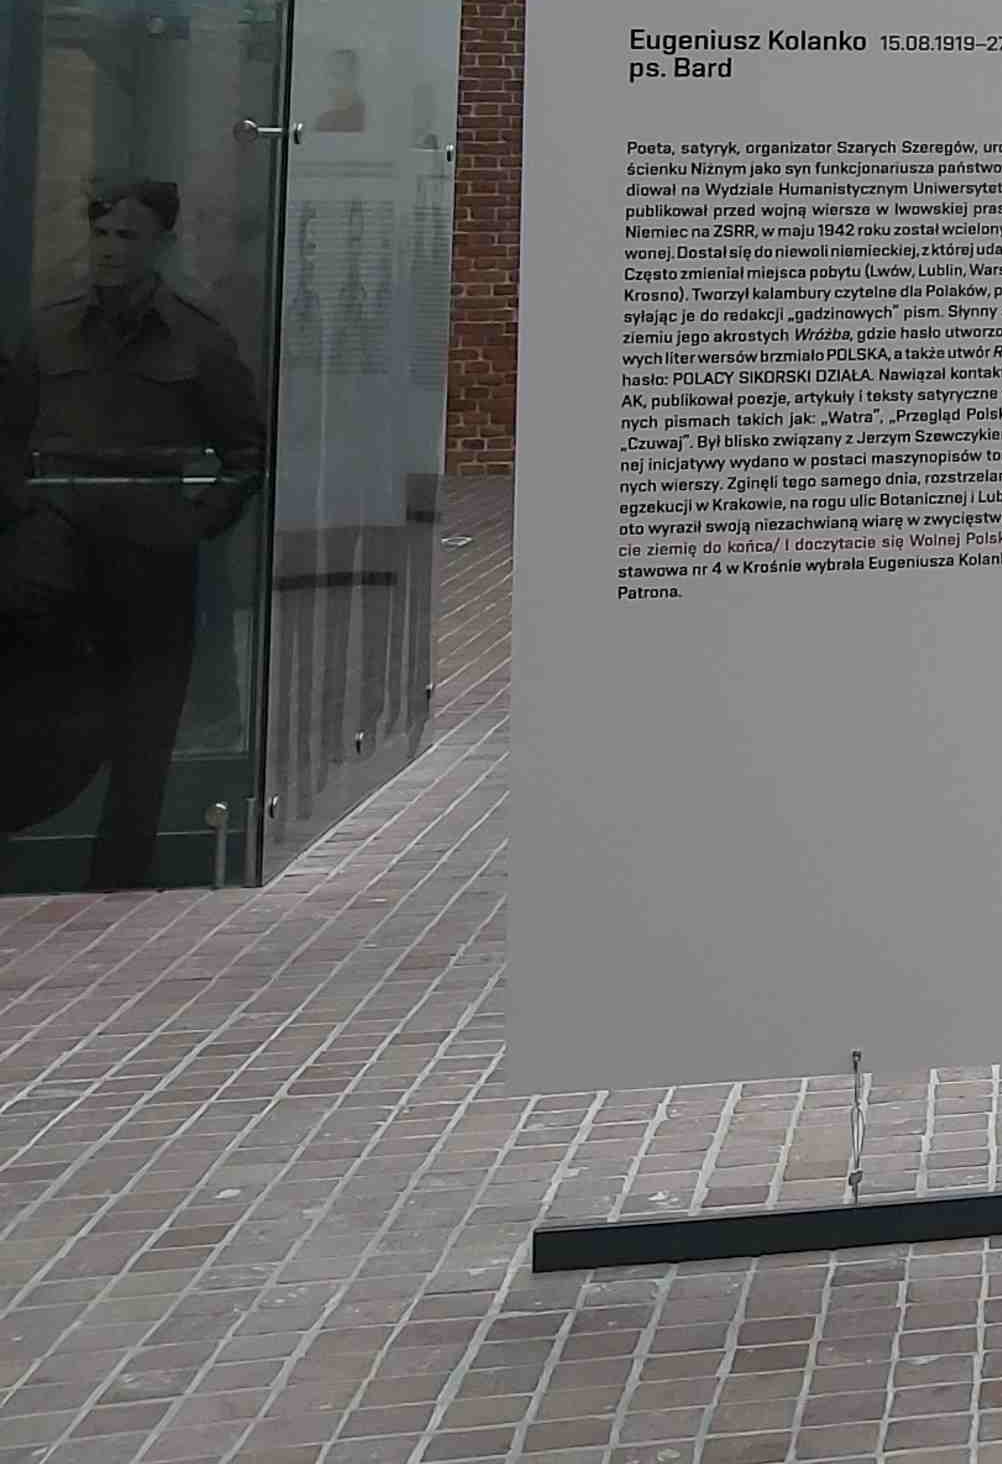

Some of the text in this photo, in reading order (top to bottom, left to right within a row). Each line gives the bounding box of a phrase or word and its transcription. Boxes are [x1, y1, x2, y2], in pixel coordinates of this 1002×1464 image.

[630, 29, 761, 55] Eugeniusz
[768, 30, 867, 50] Kolanko
[630, 57, 732, 83] ps. Bard
[627, 141, 675, 156] Poeta,
[680, 141, 740, 158] satyryk,
[745, 140, 832, 157] organizator
[836, 140, 896, 157] Szarych
[901, 140, 978, 156] Szeregów,
[626, 161, 687, 176] ścienku
[690, 161, 746, 178] Niżnym
[748, 160, 781, 178] jako
[784, 164, 811, 178] syn
[815, 160, 934, 178] funkcjonariusza
[625, 183, 676, 197] diował
[681, 186, 700, 196] na
[705, 182, 774, 199] Wydziale
[778, 181, 908, 198] Humanistycznym
[625, 203, 708, 221] publikował
[713, 203, 756, 220] przed
[760, 202, 807, 220] wojną
[811, 203, 870, 216] wiersze
[875, 205, 889, 215] w
[894, 201, 968, 218] lwowskiej
[625, 224, 688, 239] Niemiec
[691, 227, 710, 239] na
[712, 223, 759, 240] ZSRR,
[761, 227, 775, 237] w
[777, 223, 815, 240] maju
[817, 223, 855, 237] 1942
[857, 223, 891, 236] roku
[893, 222, 939, 236] został
[624, 267, 678, 284] Często
[679, 265, 744, 280] zmieniał
[747, 265, 806, 282] miejsca
[809, 264, 861, 282] pobytu
[864, 262, 915, 279] (Lwów,
[918, 263, 967, 278] Lublin,
[624, 285, 689, 303] Krosno).
[691, 287, 749, 304] Tworzył
[752, 285, 832, 302] kalambury
[834, 284, 897, 302] czytelne
[899, 284, 922, 298] dla
[925, 283, 991, 299] Polaków,
[672, 370, 735, 386] POLACY
[738, 369, 811, 384] SIKORSKI
[815, 368, 874, 382] DZIAŁA.
[878, 367, 946, 383] Nawiązał
[621, 394, 647, 409] AK,
[651, 391, 733, 410] publikował
[736, 391, 791, 409] poezje,
[794, 389, 855, 407] artykuły
[858, 389, 863, 402] i
[866, 388, 914, 404] teksty
[917, 389, 998, 404] satyryczne
[620, 457, 644, 475] nej
[648, 457, 726, 474] inicjatywy
[729, 454, 789, 472] wydano
[792, 456, 807, 467] w
[810, 451, 867, 470] postaci
[871, 448, 982, 467] maszynopisów
[618, 543, 641, 557] cie
[647, 541, 697, 558] ziemię
[703, 540, 722, 554] do
[727, 537, 780, 554] końca/
[785, 538, 789, 551] I
[794, 535, 876, 553] doczytacie
[881, 533, 904, 551] się
[909, 532, 960, 549] Wolnej
[617, 565, 688, 578] stawowa
[692, 565, 708, 576] nr
[711, 561, 722, 575] 4
[726, 564, 740, 574] w
[743, 558, 801, 574] Krośnie
[805, 556, 864, 575] wybrała
[868, 552, 954, 572] Eugeniusza
[617, 584, 683, 600] Patrona.
